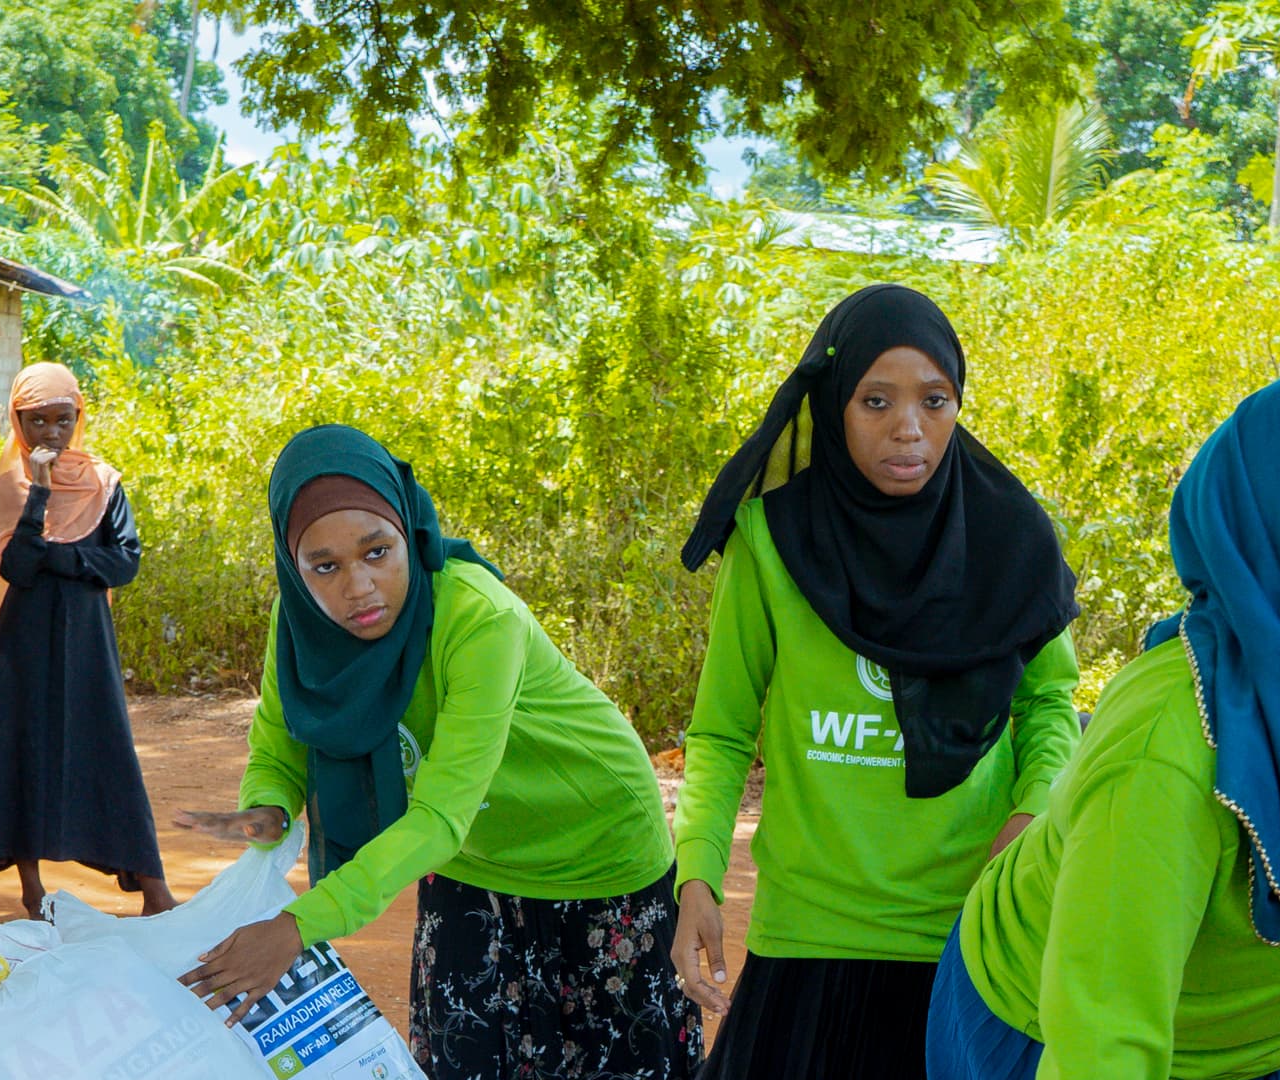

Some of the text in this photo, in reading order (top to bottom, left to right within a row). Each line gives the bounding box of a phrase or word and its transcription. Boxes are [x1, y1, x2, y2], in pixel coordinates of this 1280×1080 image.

[806, 750, 902, 767] ECONOMIC EMPOWERMENT
[259, 994, 332, 1048] RAMADHAN
[298, 1035, 331, 1059] WF-AID
